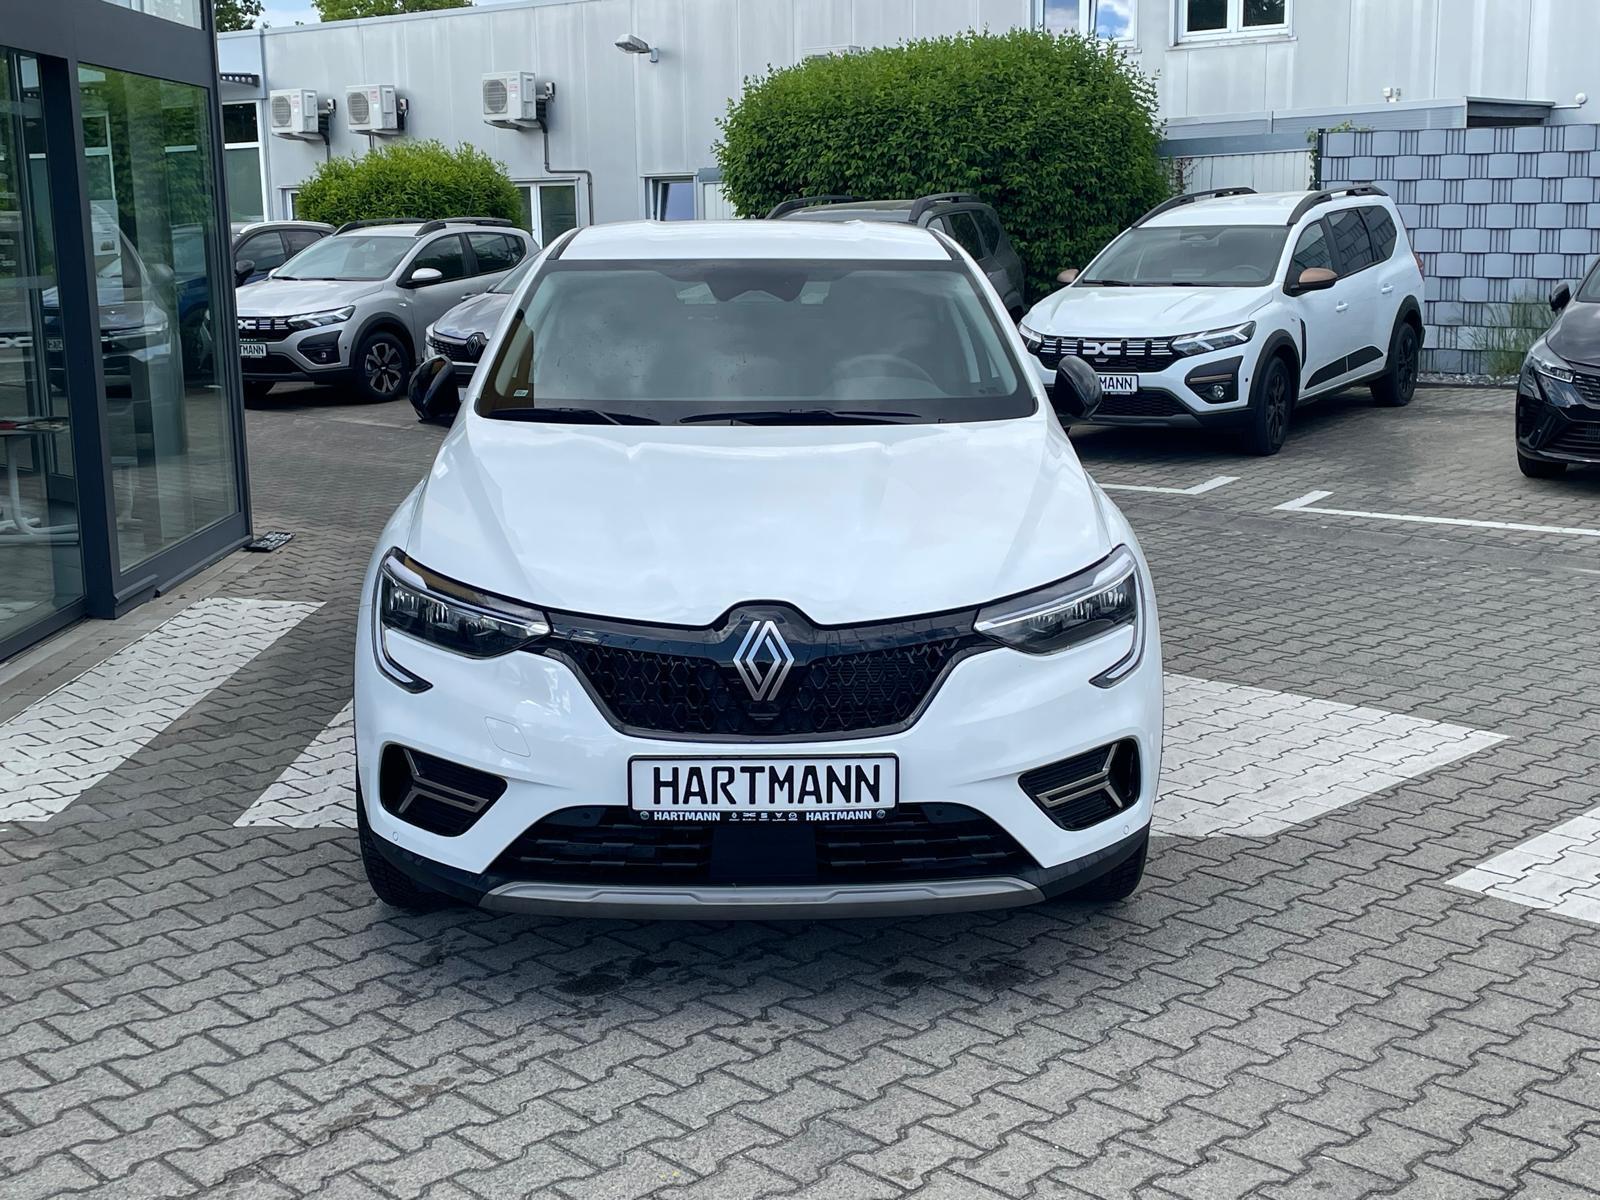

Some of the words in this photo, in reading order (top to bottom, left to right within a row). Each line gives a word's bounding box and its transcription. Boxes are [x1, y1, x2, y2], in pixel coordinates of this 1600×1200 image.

[653, 764, 880, 805] HARTMANN
[654, 811, 721, 821] HARTMANN
[805, 810, 872, 821] HARTMANN
